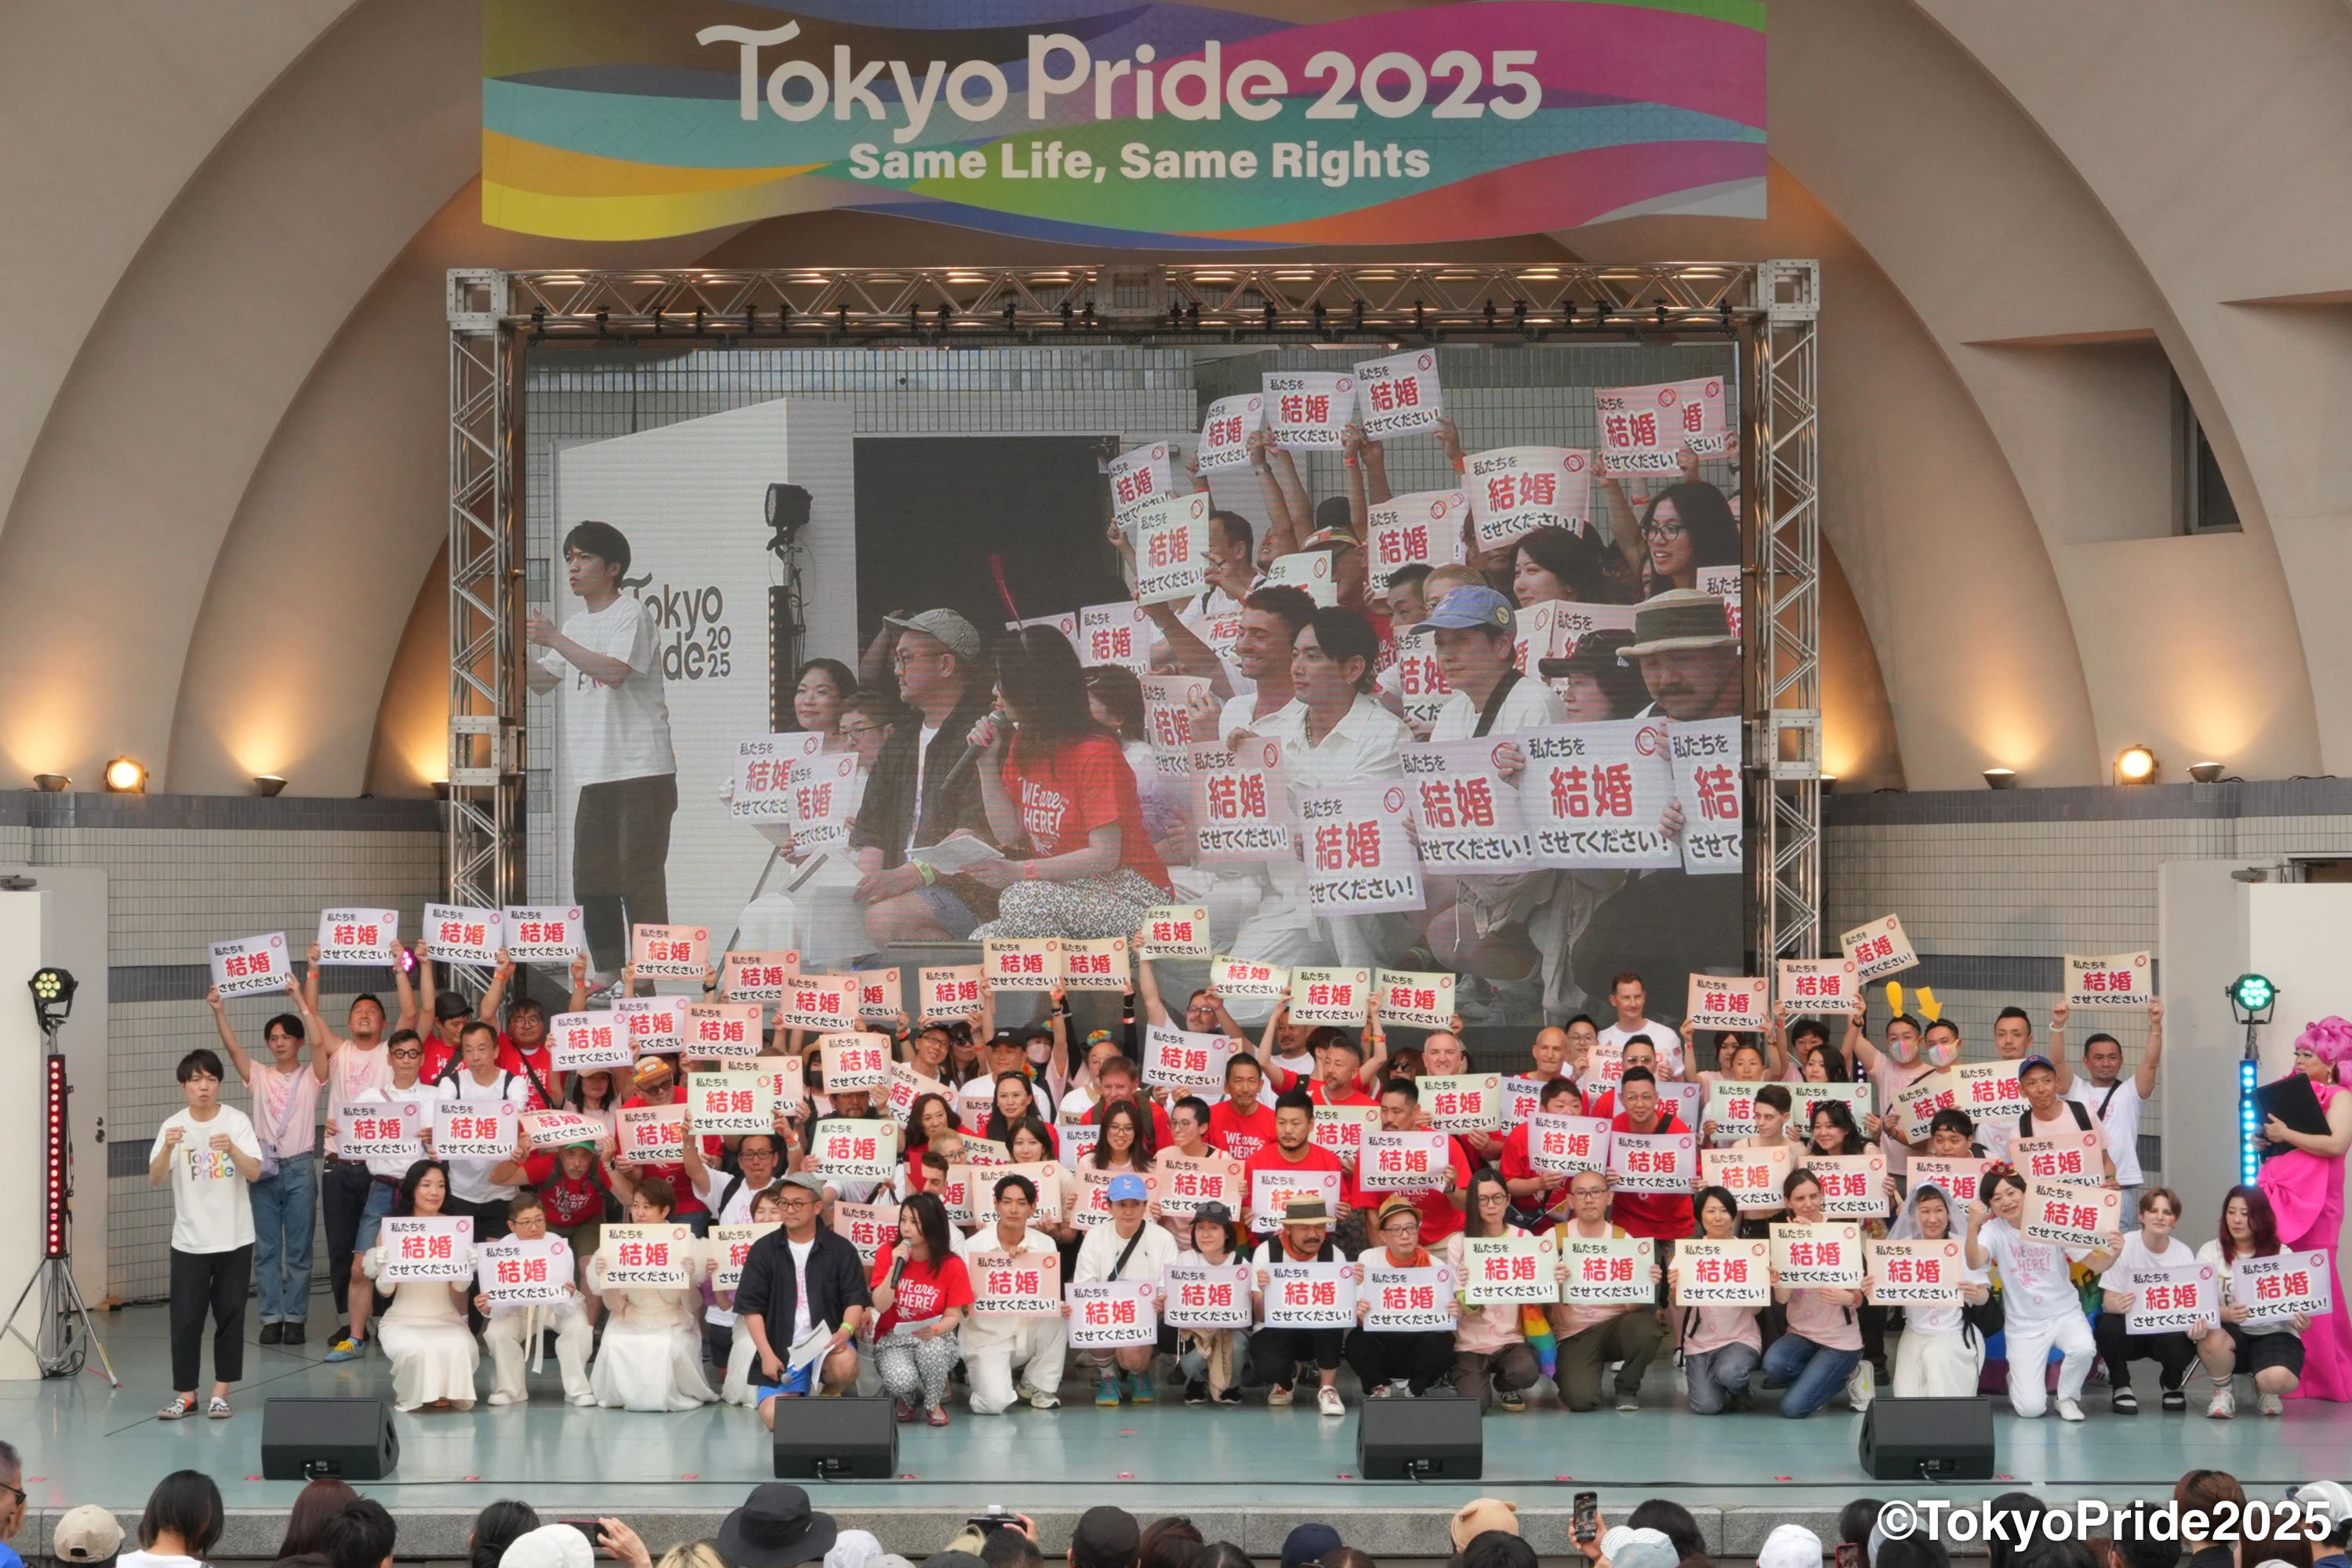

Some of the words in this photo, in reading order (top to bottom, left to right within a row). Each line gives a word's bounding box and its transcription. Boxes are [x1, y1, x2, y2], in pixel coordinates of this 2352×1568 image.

[695, 20, 1008, 140] Tokyo
[1029, 33, 1284, 121] Pride
[1305, 50, 1542, 120] 2025
[849, 142, 986, 180] Same
[1002, 142, 1105, 183] Life,
[1120, 143, 1258, 180] Same
[1272, 141, 1430, 187] Rights
[1370, 377, 1420, 412] 結婚
[1281, 396, 1330, 423] 結婚
[1606, 412, 1657, 448] 結婚
[1487, 473, 1557, 513] 結婚
[1379, 526, 1428, 564] 結婚
[707, 626, 731, 652] 20
[708, 652, 731, 678] 25
[1208, 775, 1266, 819] 結婚
[1549, 764, 1632, 819] 結婚
[1420, 778, 1494, 829] 結婚
[1316, 821, 1380, 872] 結婚
[334, 925, 377, 946] 結婚
[440, 923, 485, 945] 結婚
[520, 923, 564, 943] 結婚
[1152, 922, 1192, 942] 結婚
[648, 942, 690, 961] 結婚
[1854, 935, 1893, 964] 結婚
[225, 952, 270, 978] 結婚
[1000, 955, 1043, 974] 結婚
[1069, 955, 1110, 974] 結婚
[741, 967, 784, 986] 結婚
[1796, 976, 1840, 996] 結婚
[2083, 971, 2132, 992] 結婚
[796, 992, 840, 1013] 結婚
[936, 981, 978, 1002] 結婚
[1308, 985, 1351, 1006] 結婚
[1390, 988, 1436, 1010] 結婚
[1704, 993, 1749, 1013] 結婚
[568, 1027, 612, 1049] 結婚
[700, 1022, 743, 1041] 結婚
[840, 1051, 882, 1073] 結婚
[1160, 1047, 1207, 1072] 結婚
[706, 1091, 753, 1113] 結婚
[1973, 1080, 2019, 1102] 結婚
[1435, 1092, 1481, 1114] 結婚
[354, 1120, 401, 1139] 結婚
[451, 1118, 496, 1139] 結婚
[1316, 1123, 1361, 1145] 結婚
[828, 1138, 876, 1160] 結婚
[1543, 1132, 1590, 1156] 結婚
[1379, 1150, 1428, 1172] 結婚
[1628, 1152, 1675, 1174] 結婚
[2031, 1151, 2081, 1176] 結婚
[191, 1164, 234, 1181] Pride
[1722, 1166, 1769, 1189] 結婚
[1174, 1174, 1222, 1198] 結婚
[1819, 1174, 1866, 1196] 結婚
[2043, 1200, 2097, 1231] 結婚
[401, 1236, 452, 1259] 結婚
[619, 1243, 668, 1266] 結婚
[1790, 1243, 1840, 1265] 結婚
[498, 1259, 546, 1283] 結婚
[1485, 1257, 1535, 1280] 結婚
[1583, 1258, 1633, 1281] 結婚
[1697, 1259, 1747, 1283] 結婚
[1888, 1260, 1940, 1283] 結婚
[898, 1279, 914, 1293] WE
[989, 1272, 1038, 1294] 結婚
[1285, 1282, 1335, 1305] 結婚
[2256, 1272, 2308, 1300] 結婚
[899, 1292, 936, 1311] HERE!
[1181, 1284, 1232, 1306] 結婚
[1383, 1287, 1433, 1309] 結婚
[2146, 1284, 2197, 1310] 結婚
[1085, 1300, 1135, 1324] 結婚
